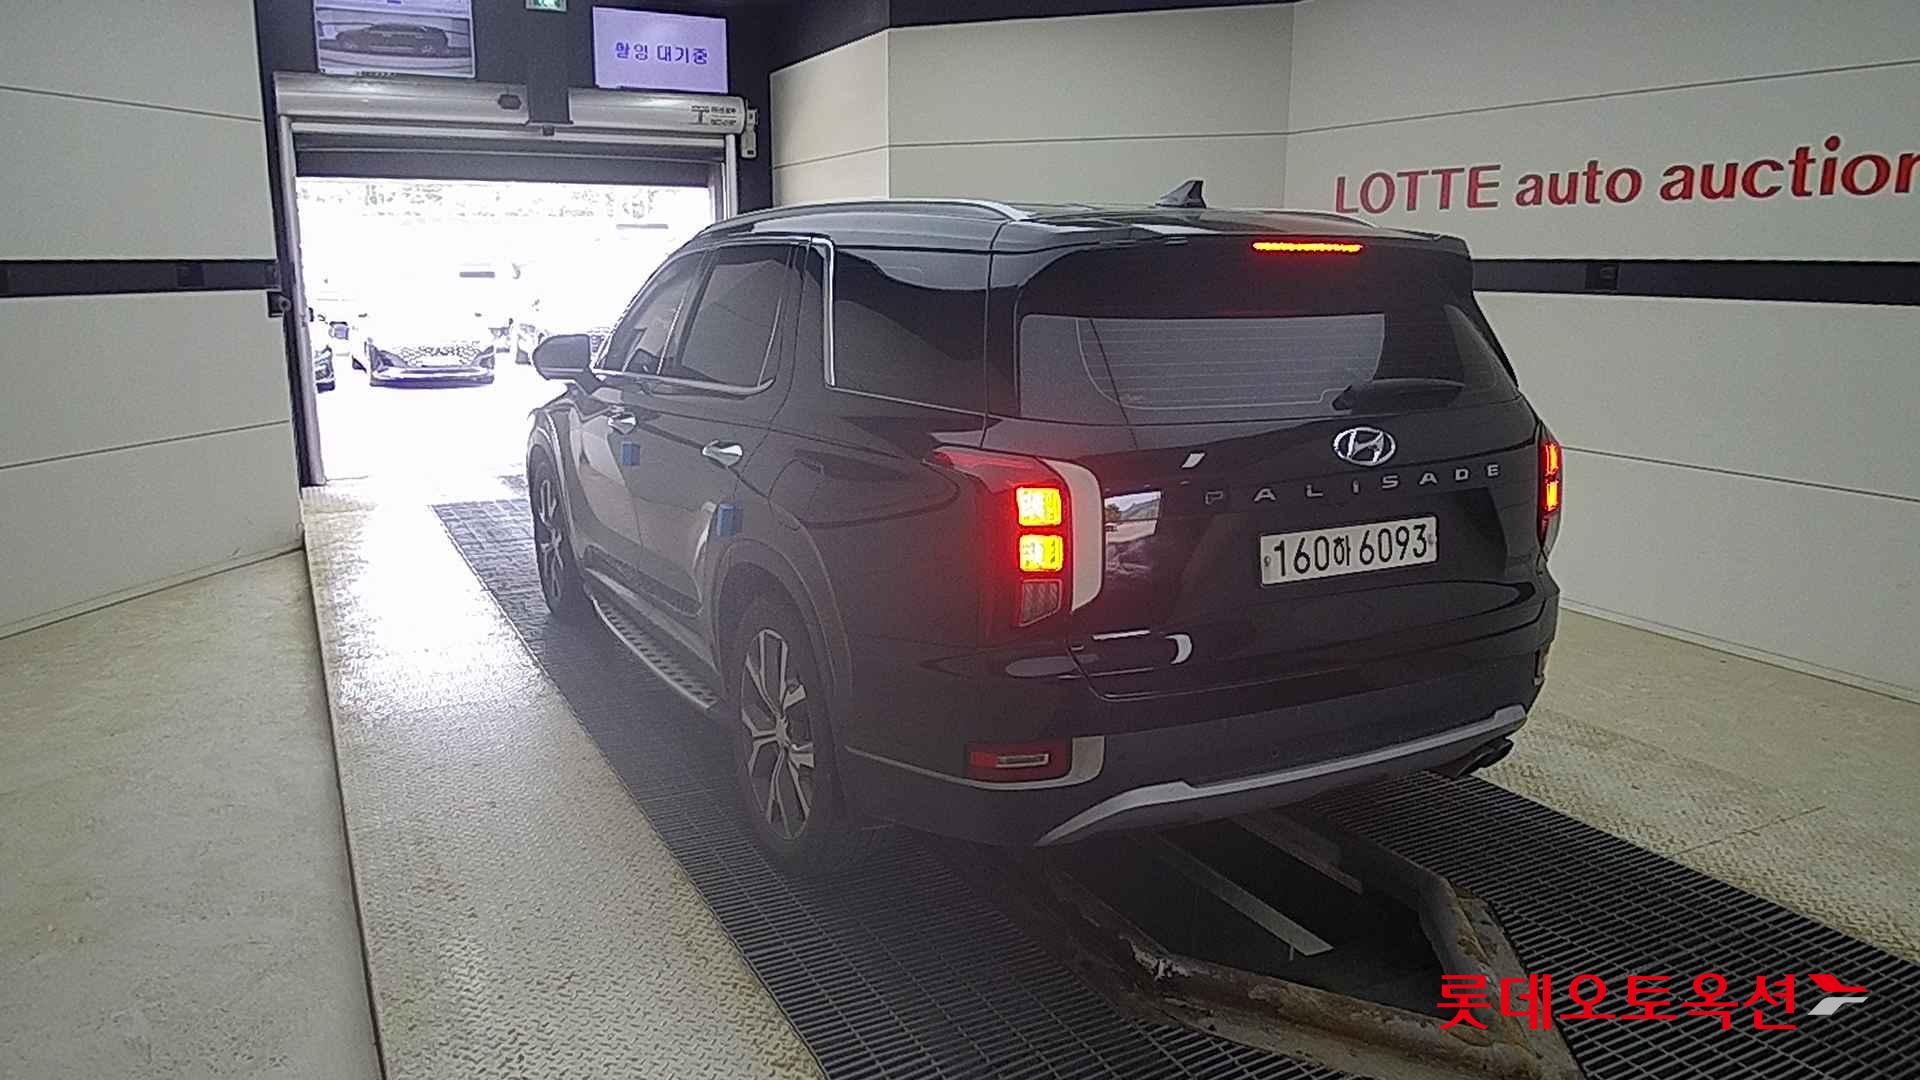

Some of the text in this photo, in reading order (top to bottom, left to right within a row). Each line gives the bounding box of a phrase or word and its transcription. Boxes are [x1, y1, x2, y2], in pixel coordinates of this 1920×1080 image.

[657, 45, 708, 65] 대기중
[1335, 164, 1501, 214] LOTTE
[1515, 160, 1643, 207] auto
[1205, 464, 1499, 505] PALISADE
[1359, 523, 1428, 567] 6093
